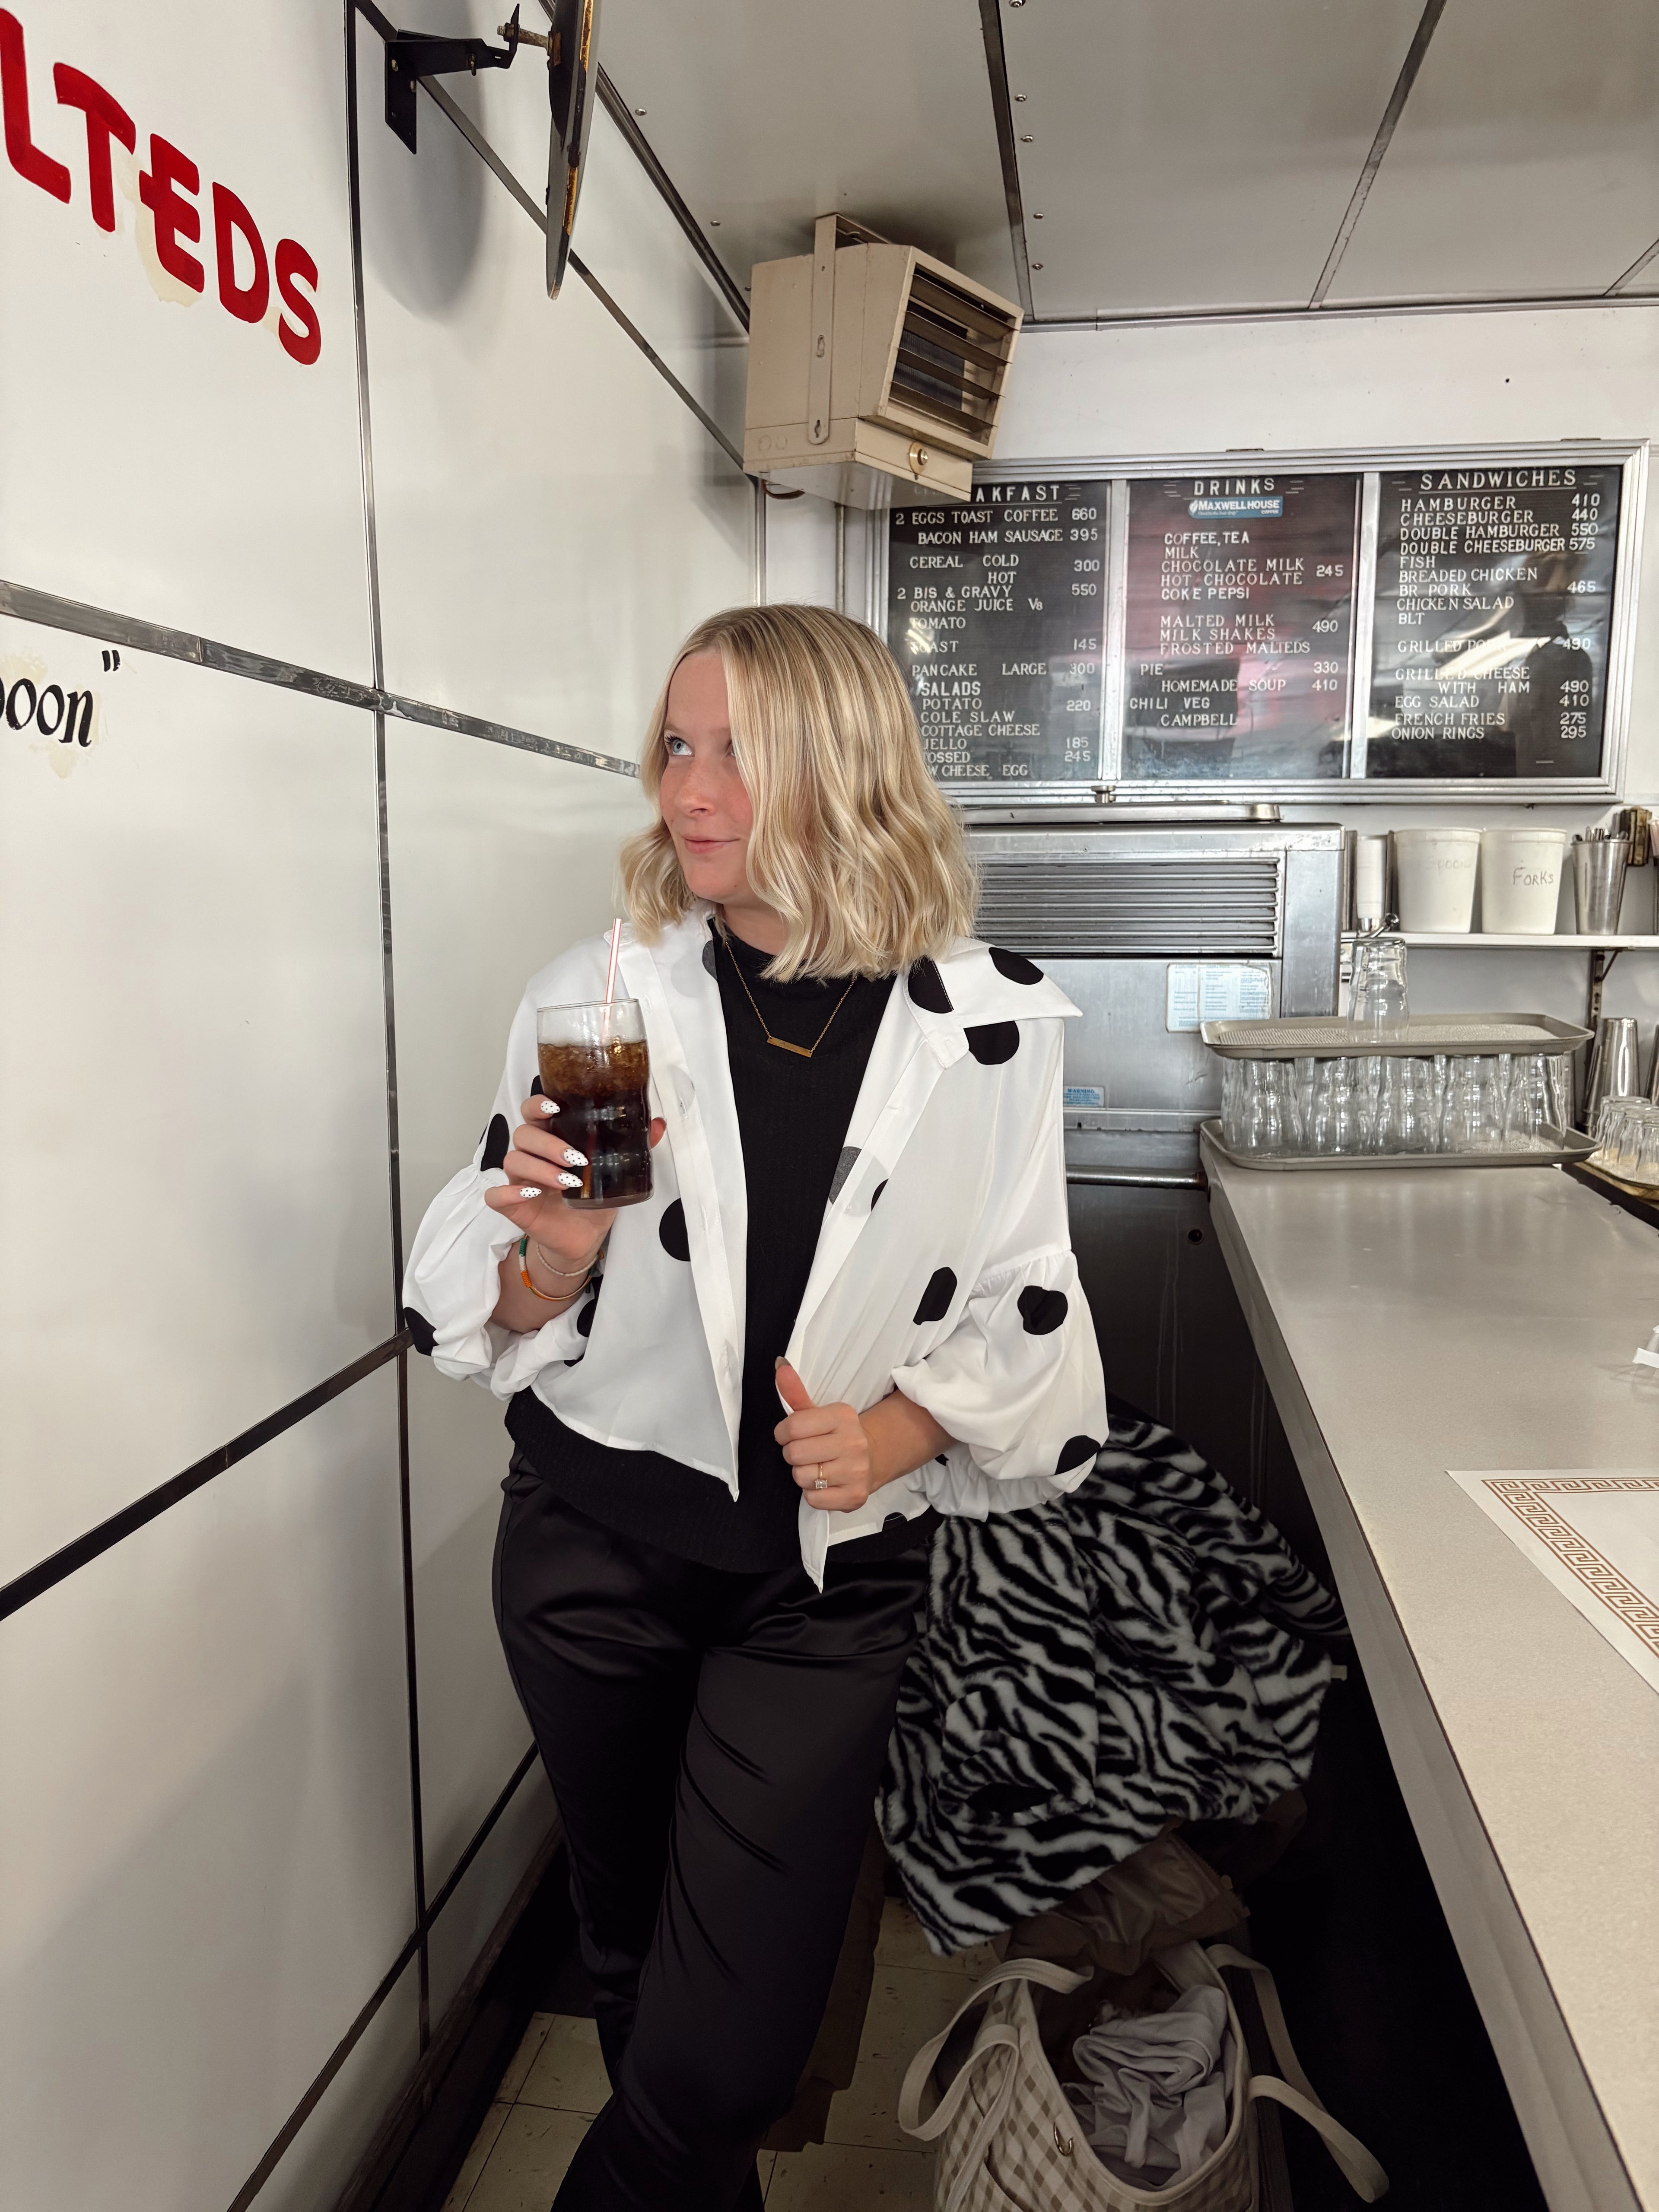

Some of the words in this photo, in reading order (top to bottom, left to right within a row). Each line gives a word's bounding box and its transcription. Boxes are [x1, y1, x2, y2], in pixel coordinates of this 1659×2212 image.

[1194, 478, 1274, 495] DRINKS
[1421, 469, 1576, 490] SANDWICHES
[976, 485, 1059, 502] AKFAST
[1198, 500, 1246, 511] MAXWELL
[1247, 499, 1280, 509] HOUSE
[1401, 496, 1516, 512] HAMBURGER
[1572, 493, 1600, 507] 410
[896, 513, 904, 524] 2
[912, 512, 944, 524] EGGS
[951, 511, 993, 524] TOAST
[1004, 509, 1058, 522] COFFEE
[1072, 508, 1096, 520] 660
[1401, 510, 1533, 526] CHEESEBURGER
[1572, 508, 1598, 521] 440
[918, 531, 961, 544] BACON
[969, 531, 998, 543] HAM
[1004, 529, 1063, 543] SAUSAGE
[1070, 528, 1097, 541] 395
[1401, 527, 1459, 540] DOUBLE
[1465, 524, 1559, 539] HAMBURGER
[1571, 523, 1598, 536] 550
[1165, 546, 1199, 559] MILK
[1401, 541, 1457, 555] DOUBLE
[1465, 538, 1565, 553] CHEESEBURGER
[1569, 537, 1595, 550] 575
[910, 556, 963, 568] CEREAL
[983, 554, 1019, 566] COLD
[1074, 559, 1100, 572] 300
[1162, 559, 1257, 572] CHOCOLATE
[1266, 558, 1304, 571] MILK
[1316, 565, 1343, 577] 245
[1400, 555, 1435, 569] FISH
[988, 572, 1017, 584] HOT
[1161, 574, 1192, 587] HOT
[1204, 572, 1302, 586] CHOCOLATE
[1399, 569, 1466, 583] BREADED
[1471, 567, 1537, 581] CHICKEN
[897, 588, 906, 599] 2
[946, 587, 955, 598] &
[961, 585, 1011, 598] GRAVY
[1072, 584, 1096, 595] 550
[1162, 588, 1201, 600] COKE
[1208, 587, 1249, 599] PEPSI
[1400, 585, 1417, 597] BR
[1429, 583, 1471, 597] PORK
[1567, 580, 1596, 593] 465
[911, 600, 966, 612] ORANGE
[974, 598, 1013, 611] JUICE
[1397, 597, 1459, 610] CHICKEN
[1463, 596, 1514, 610] SALAD
[911, 617, 966, 629] TOMATO
[1161, 615, 1224, 627] MALTED
[1236, 614, 1274, 626] MILK
[1312, 620, 1338, 632] 490
[1399, 612, 1425, 624] BLT
[1160, 629, 1201, 641] MILK
[1210, 628, 1275, 640] SHAKES
[1074, 639, 1096, 650] 145
[1161, 642, 1234, 655] FROSTED
[1246, 641, 1310, 654] MALTEDS
[1398, 639, 1462, 652] GRILLED
[1561, 638, 1591, 649] 490
[912, 664, 977, 676] PANCAKE
[1002, 663, 1046, 675] LARGE
[1070, 663, 1094, 674] 300
[1141, 664, 1163, 675] PIE
[1314, 661, 1338, 674] 330
[1395, 668, 1467, 680] GRILLED
[922, 682, 981, 696] SALADS
[1162, 680, 1237, 693] HOMEMADE
[1249, 679, 1286, 691] SOUP
[1312, 679, 1338, 691] 410
[1438, 681, 1476, 694] WITH
[1498, 681, 1529, 693] HAM
[1560, 680, 1589, 693] 490
[923, 698, 982, 710] POTATO
[1067, 700, 1090, 711] 220
[1130, 698, 1167, 709] CHILI
[1184, 697, 1210, 709] VEG
[1395, 695, 1421, 708] EGG
[1430, 695, 1479, 708] SALAD
[1559, 694, 1589, 706] 410
[921, 712, 961, 723] COLE
[970, 711, 1015, 722] SLAW
[1161, 714, 1236, 726] CAMPBELL
[1395, 713, 1454, 725] FRENCH
[1461, 713, 1505, 725] FRIES
[1560, 712, 1586, 725] 275
[922, 725, 982, 737] COTTAGE
[988, 724, 1040, 736] CHEESE
[1392, 727, 1434, 740] ONION
[1443, 727, 1484, 739] RINGS
[1561, 725, 1586, 739] 295
[924, 738, 967, 750] JELLO
[1067, 737, 1088, 749] 185
[1065, 750, 1090, 762] 245
[941, 764, 989, 776] CHEESE
[1002, 764, 1028, 776] EGG
